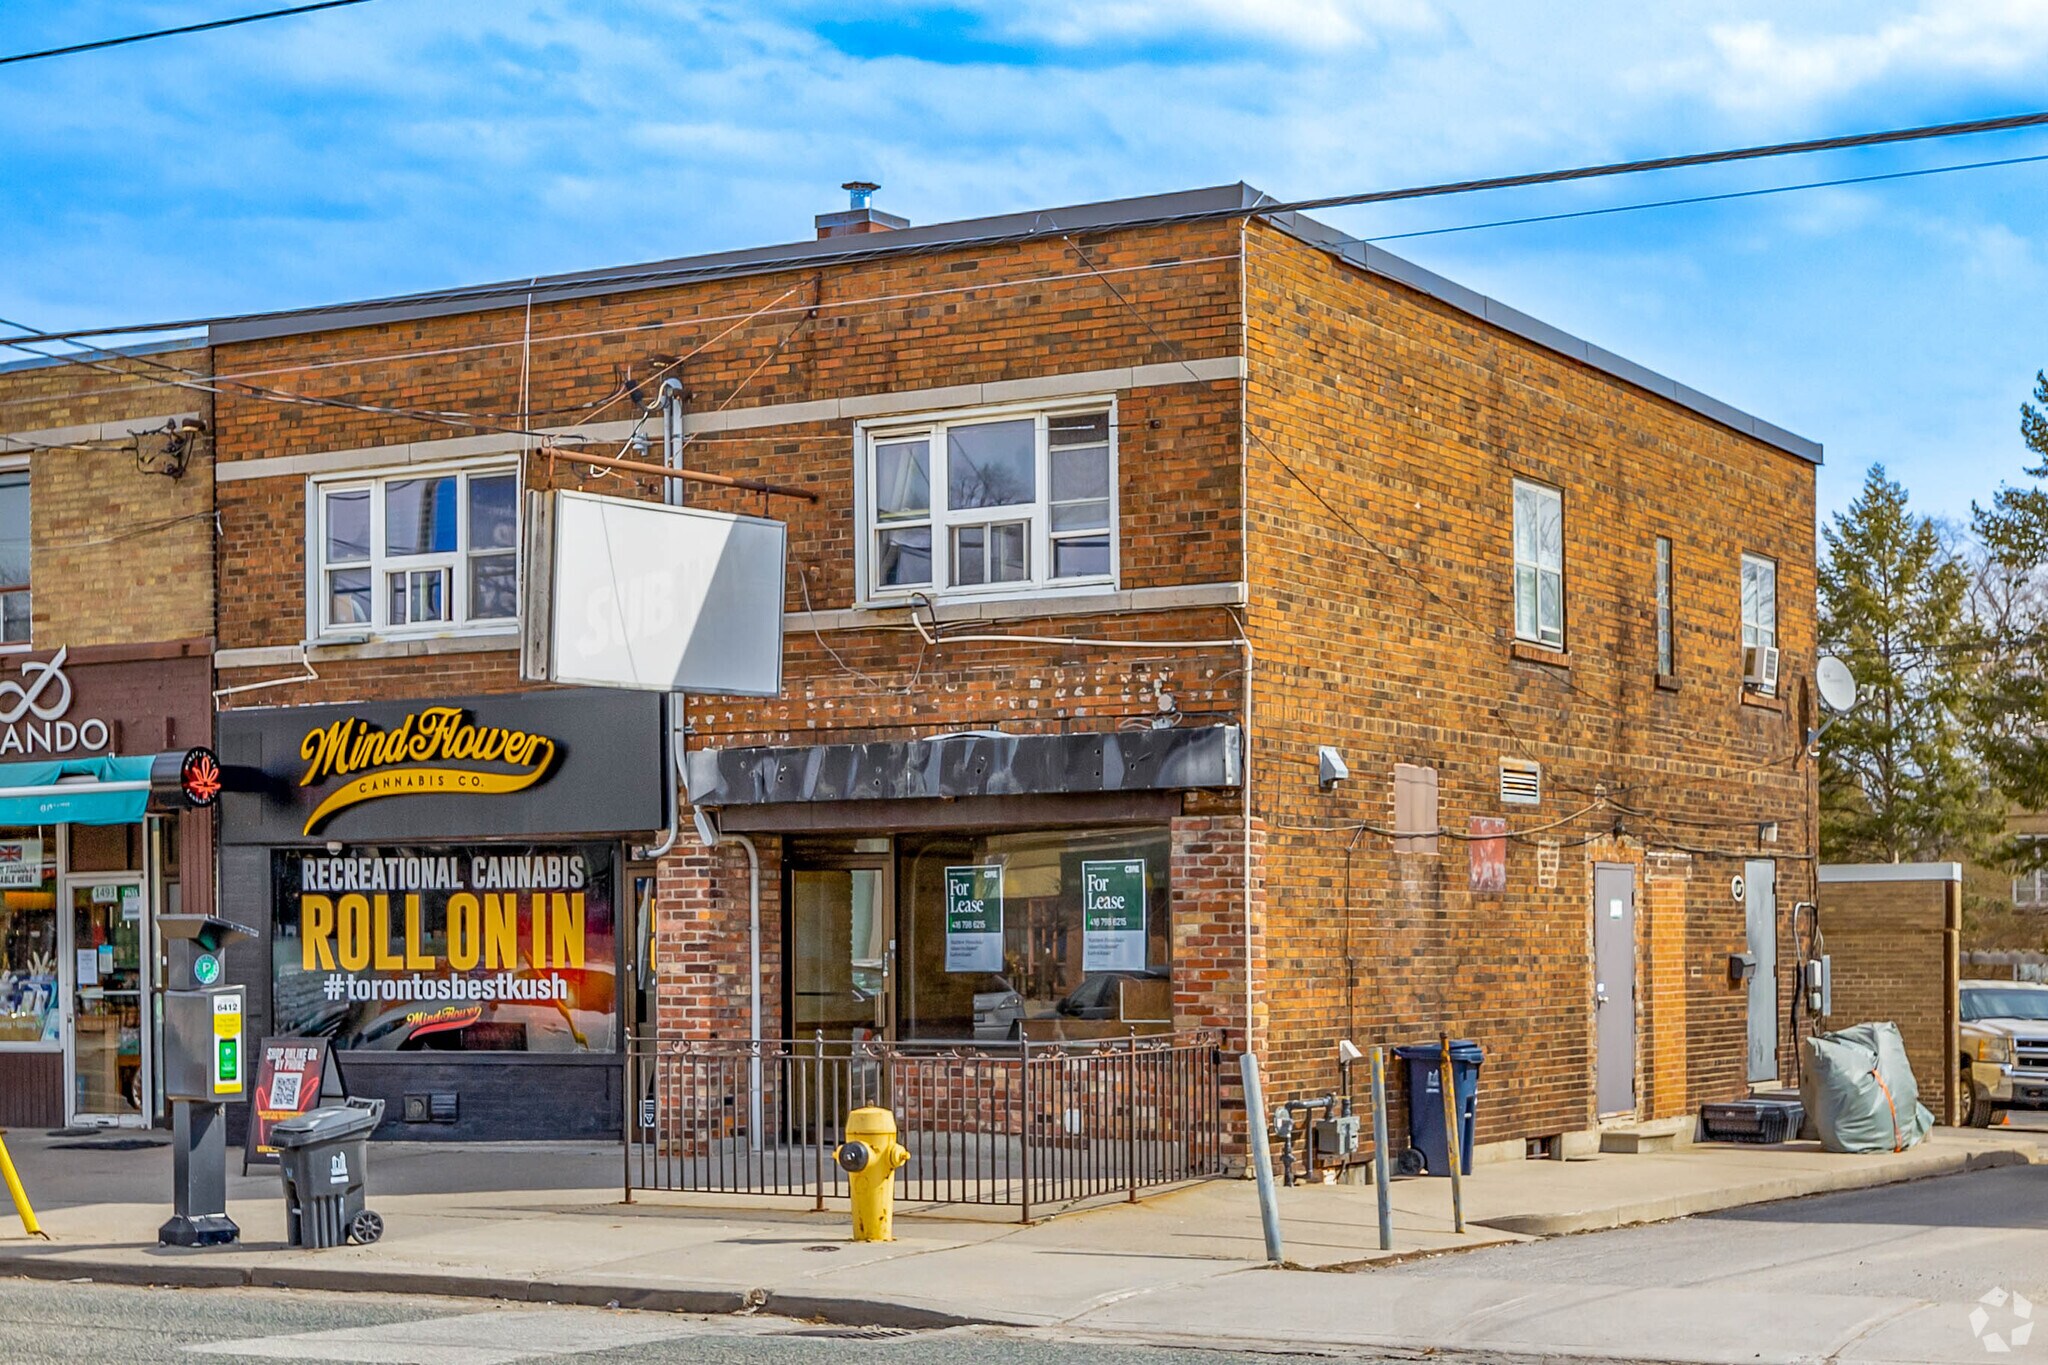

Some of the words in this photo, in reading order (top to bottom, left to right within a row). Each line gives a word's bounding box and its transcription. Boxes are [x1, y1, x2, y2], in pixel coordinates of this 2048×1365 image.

[300, 706, 554, 786] MindFlower
[359, 775, 444, 793] CANNABIS
[458, 775, 484, 788] CO.
[302, 857, 464, 891] RECREATIONAL
[471, 856, 585, 890] CANNABIS
[949, 879, 970, 896] For
[1087, 874, 1109, 892] For
[950, 896, 984, 913] Lease
[1088, 892, 1125, 910] Lease
[301, 893, 436, 971] ROLL
[446, 892, 518, 971] ON
[532, 892, 586, 970] IN
[323, 972, 568, 1001] #torontosbestkush
[217, 1003, 238, 1012] 6412
